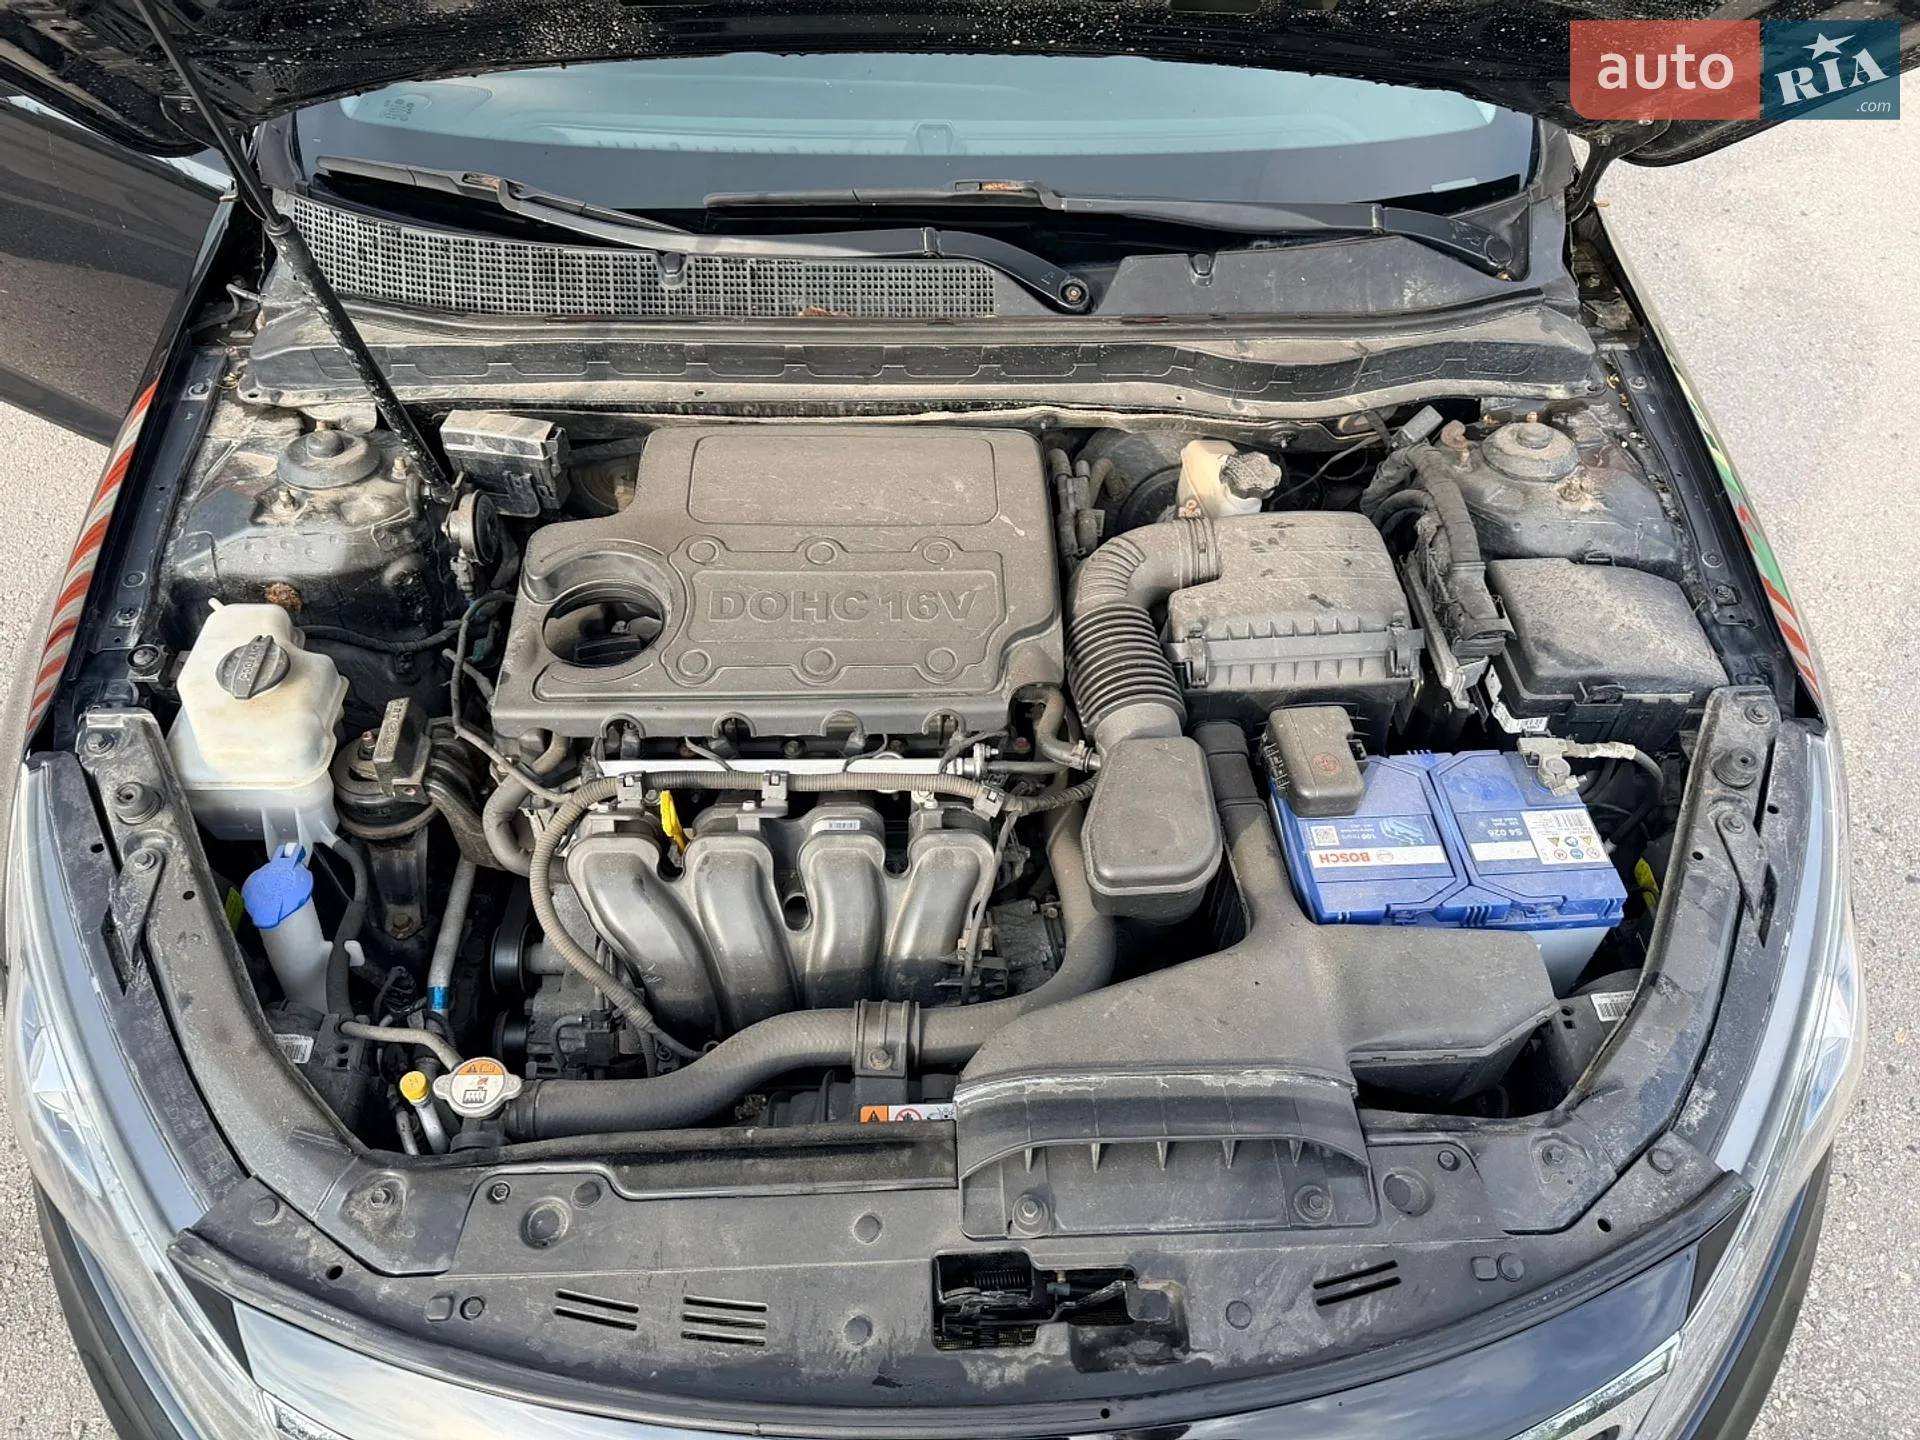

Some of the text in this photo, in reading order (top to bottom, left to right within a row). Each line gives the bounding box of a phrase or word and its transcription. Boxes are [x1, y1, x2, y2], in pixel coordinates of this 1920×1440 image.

[708, 589, 979, 623] DOHC 16V
[1318, 851, 1371, 865] BOSCH
